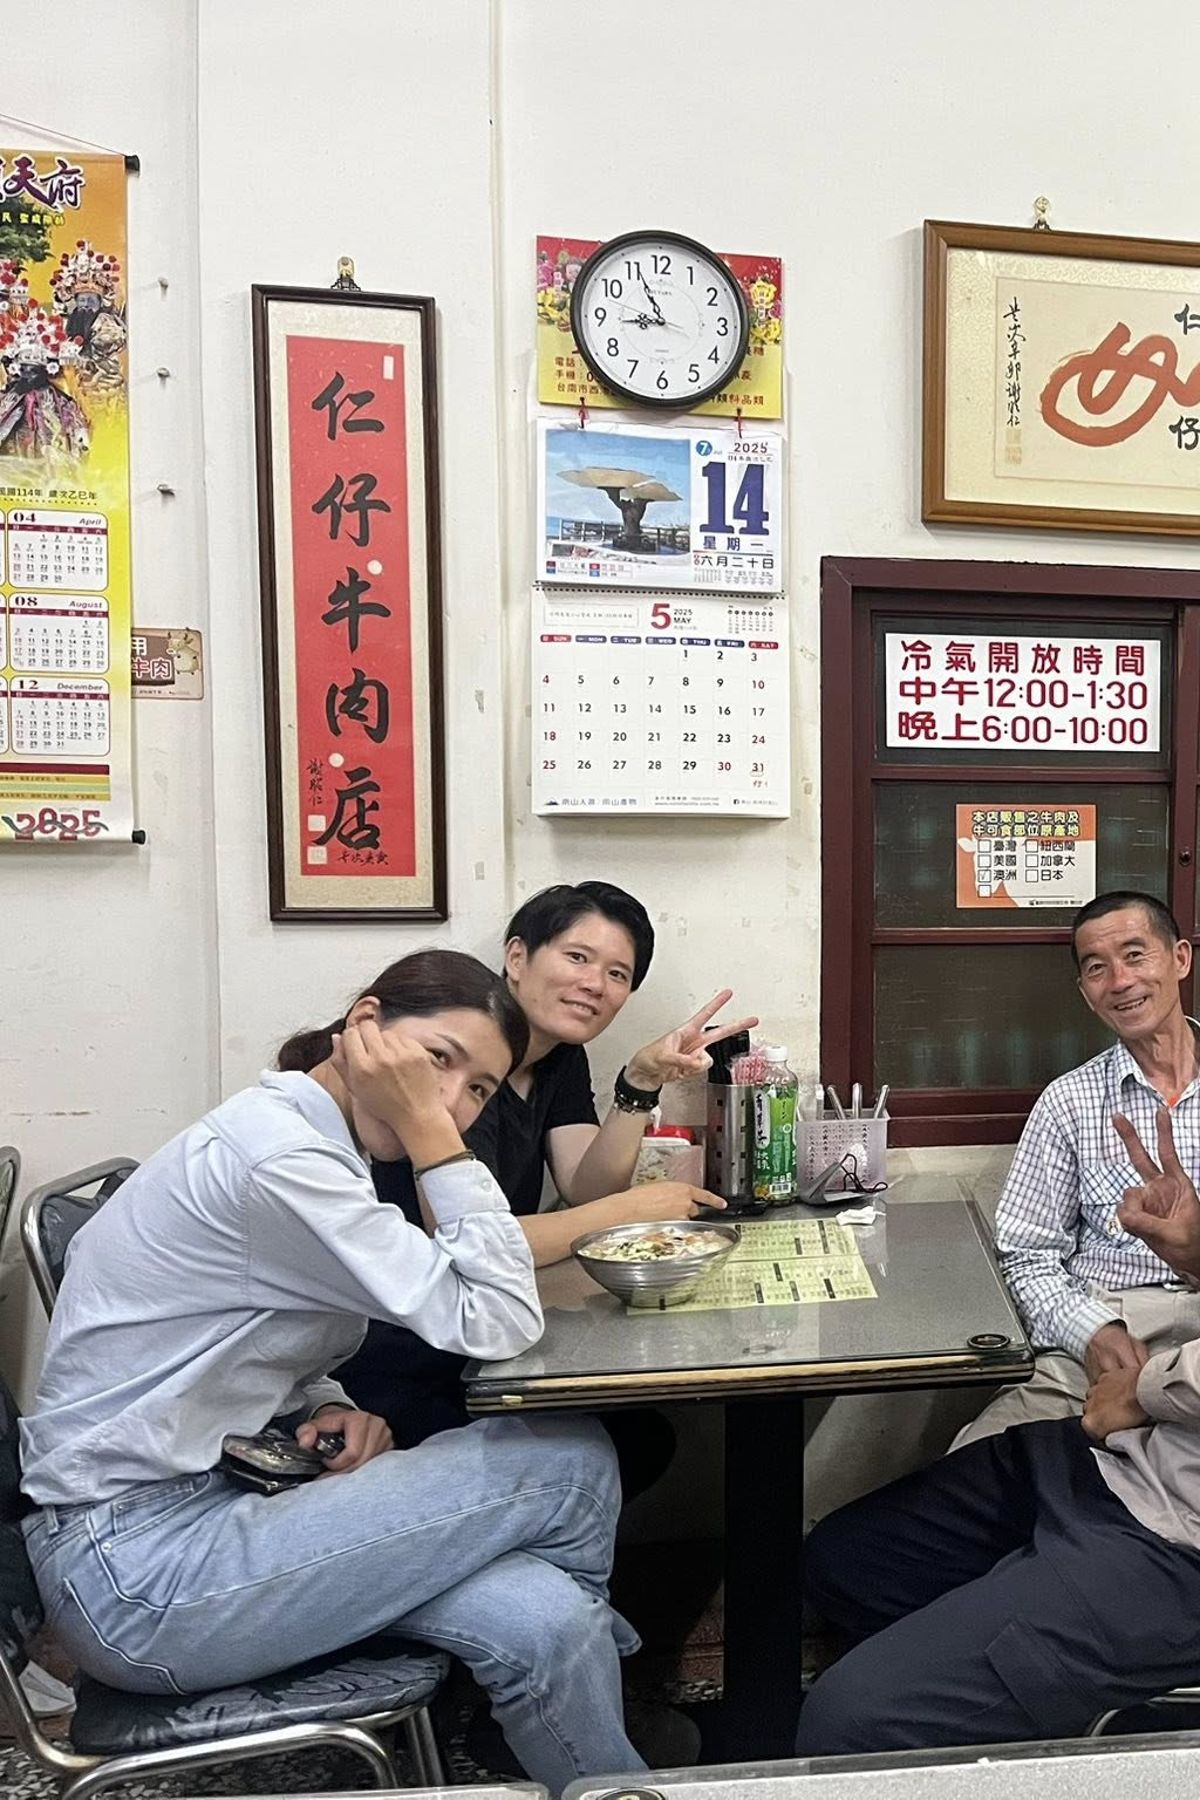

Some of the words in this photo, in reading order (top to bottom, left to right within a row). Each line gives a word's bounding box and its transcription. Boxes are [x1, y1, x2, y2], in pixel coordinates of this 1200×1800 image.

[0, 155, 83, 210] 天府
[625, 261, 641, 280] 11
[652, 255, 671, 275] 12
[687, 267, 693, 285] 1
[602, 279, 622, 298] 10
[707, 287, 717, 306] 2
[595, 307, 606, 327] 9
[717, 317, 728, 336] 3
[607, 338, 619, 356] 8
[708, 346, 719, 364] 4
[628, 360, 639, 378] 7
[688, 364, 699, 382] 5
[657, 371, 668, 389] 6
[734, 442, 769, 454] 2025
[700, 462, 769, 535] 14
[14, 512, 36, 522] 04
[79, 518, 102, 526] April
[703, 536, 764, 551] 星期一
[701, 555, 774, 569] 六月二十日
[15, 596, 38, 607] 08
[69, 600, 102, 609] August
[311, 370, 392, 851] 仁仔牛肉店
[651, 603, 672, 630] 5
[674, 608, 693, 616] 2025
[674, 617, 692, 625] MAY
[683, 649, 688, 659] 1
[717, 650, 724, 661] 2
[750, 652, 758, 662] 3
[901, 640, 1145, 676] 冷氣開放時間
[131, 657, 172, 680] 牛肉
[19, 680, 39, 690] 12
[57, 682, 103, 691] December
[542, 674, 550, 684] 4
[577, 674, 585, 685] 5
[612, 675, 620, 686] 6
[648, 676, 655, 686] 7
[682, 676, 690, 687] 8
[716, 678, 724, 688] 9
[752, 679, 765, 690] 10
[543, 702, 555, 713] 11
[578, 702, 592, 713] 12
[613, 703, 627, 714] 13
[649, 704, 662, 714] 14
[683, 704, 697, 715] 15
[718, 705, 731, 716] 16
[752, 707, 765, 717] 17
[543, 730, 557, 742] 18
[578, 731, 592, 741] 19
[612, 731, 628, 742] 20
[647, 731, 661, 742] 21
[683, 732, 697, 743] 22
[717, 733, 731, 744] 23
[751, 734, 766, 744] 24
[542, 759, 557, 770] 25
[577, 759, 592, 770] 26
[612, 759, 627, 770] 27
[647, 760, 662, 771] 28
[682, 760, 697, 770] 29
[717, 761, 732, 772] 30
[751, 762, 764, 773] 31
[972, 811, 1079, 824] 本店販售之牛肉及
[993, 855, 1017, 867] 美國
[993, 870, 1017, 881] 澳洲
[1040, 870, 1064, 881] 日本
